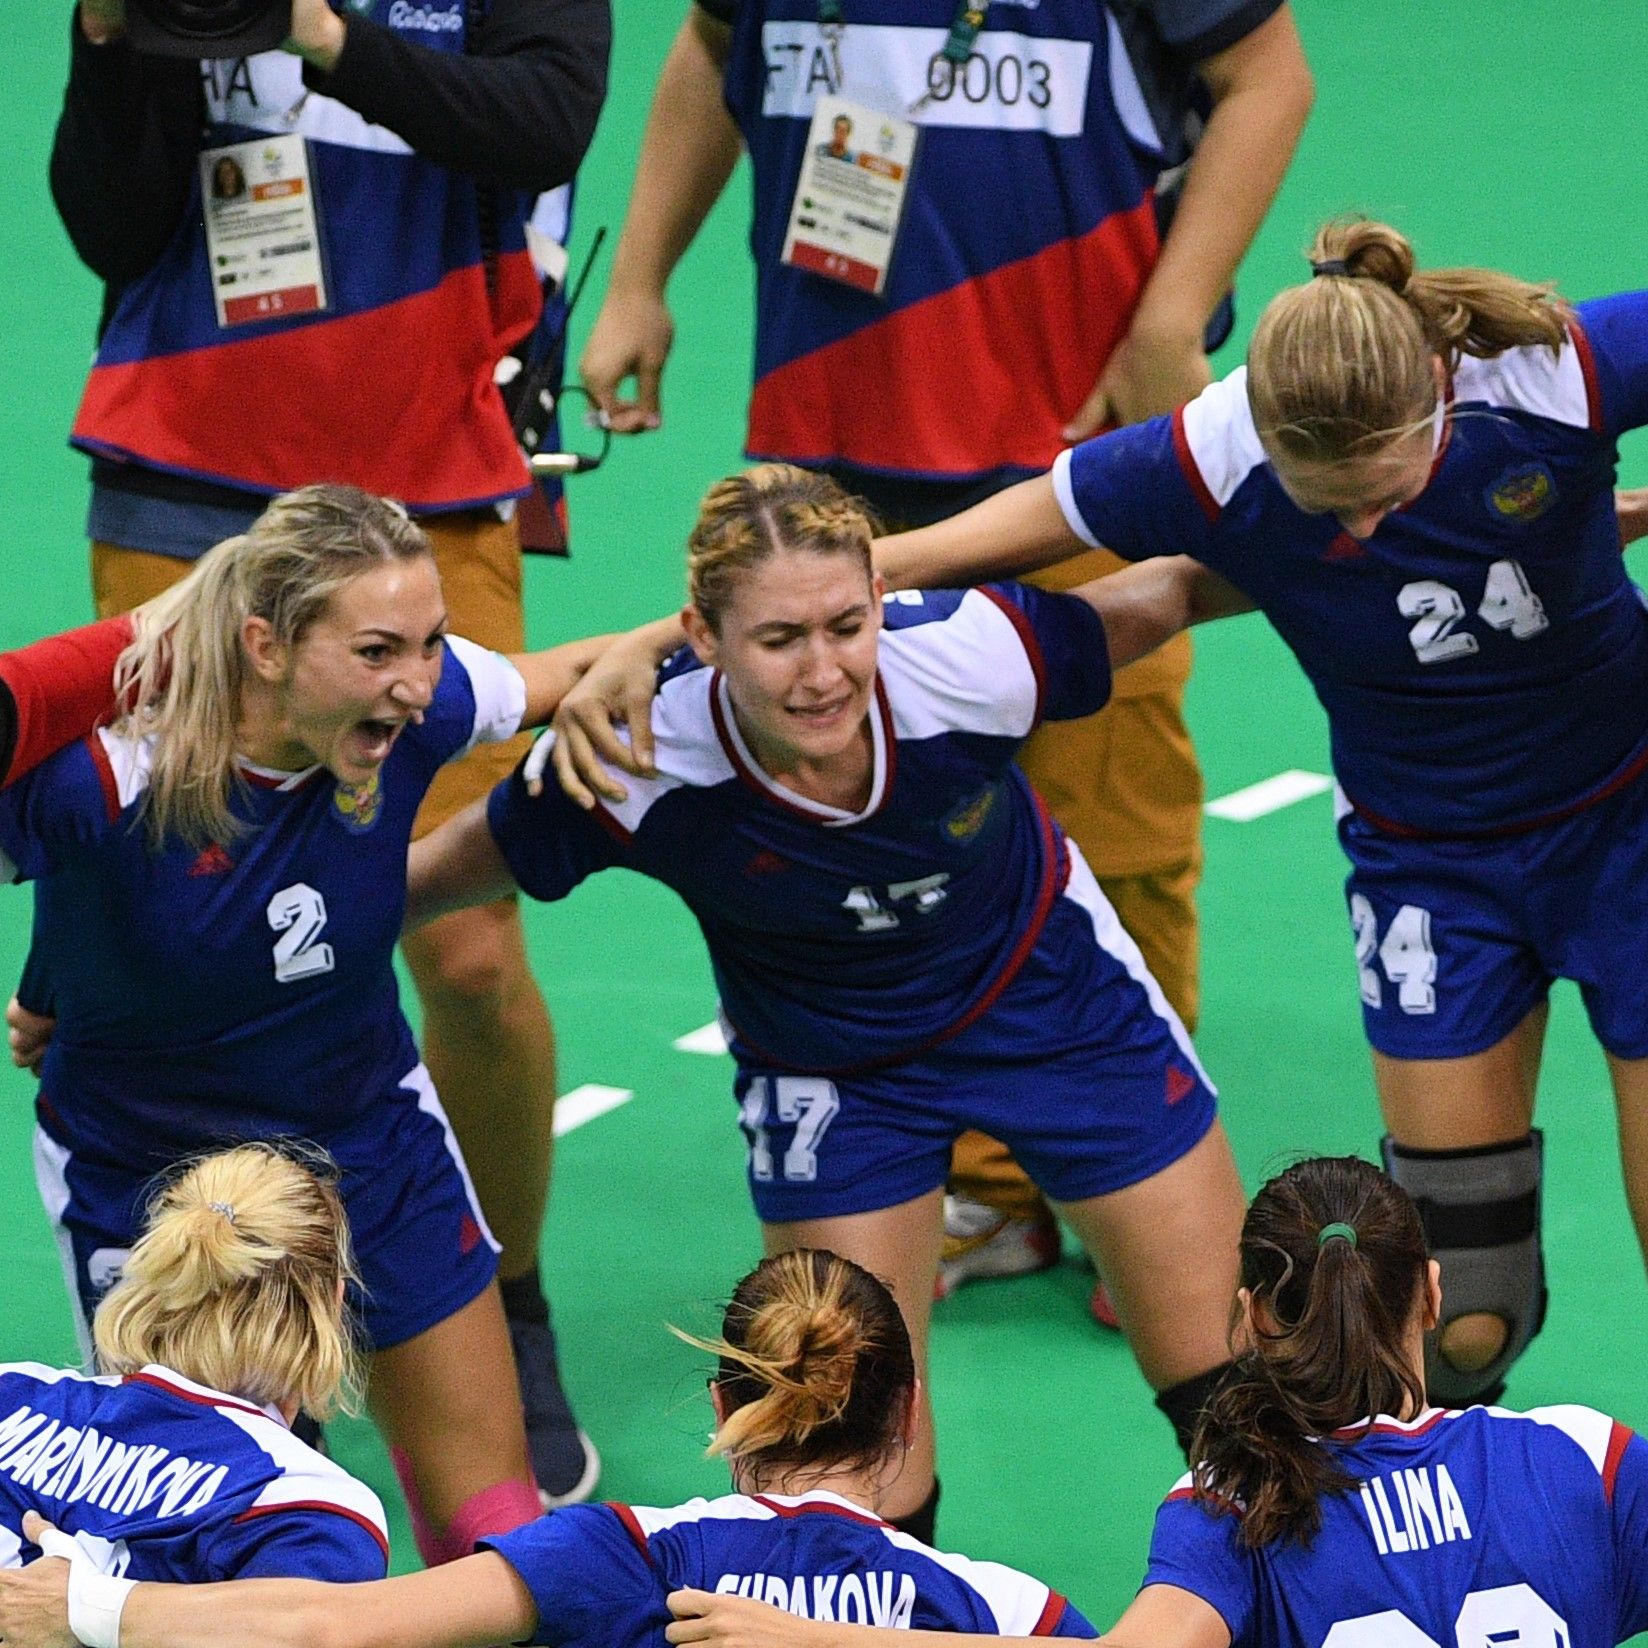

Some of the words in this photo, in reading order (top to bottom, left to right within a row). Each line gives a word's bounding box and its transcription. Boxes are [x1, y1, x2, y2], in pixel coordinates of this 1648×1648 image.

[927, 51, 1052, 108] 0003
[1396, 558, 1550, 664] 24
[266, 882, 334, 982] 2
[1350, 892, 1438, 1015] 24
[735, 1075, 840, 1182] 17
[1360, 1463, 1472, 1556] ILINA
